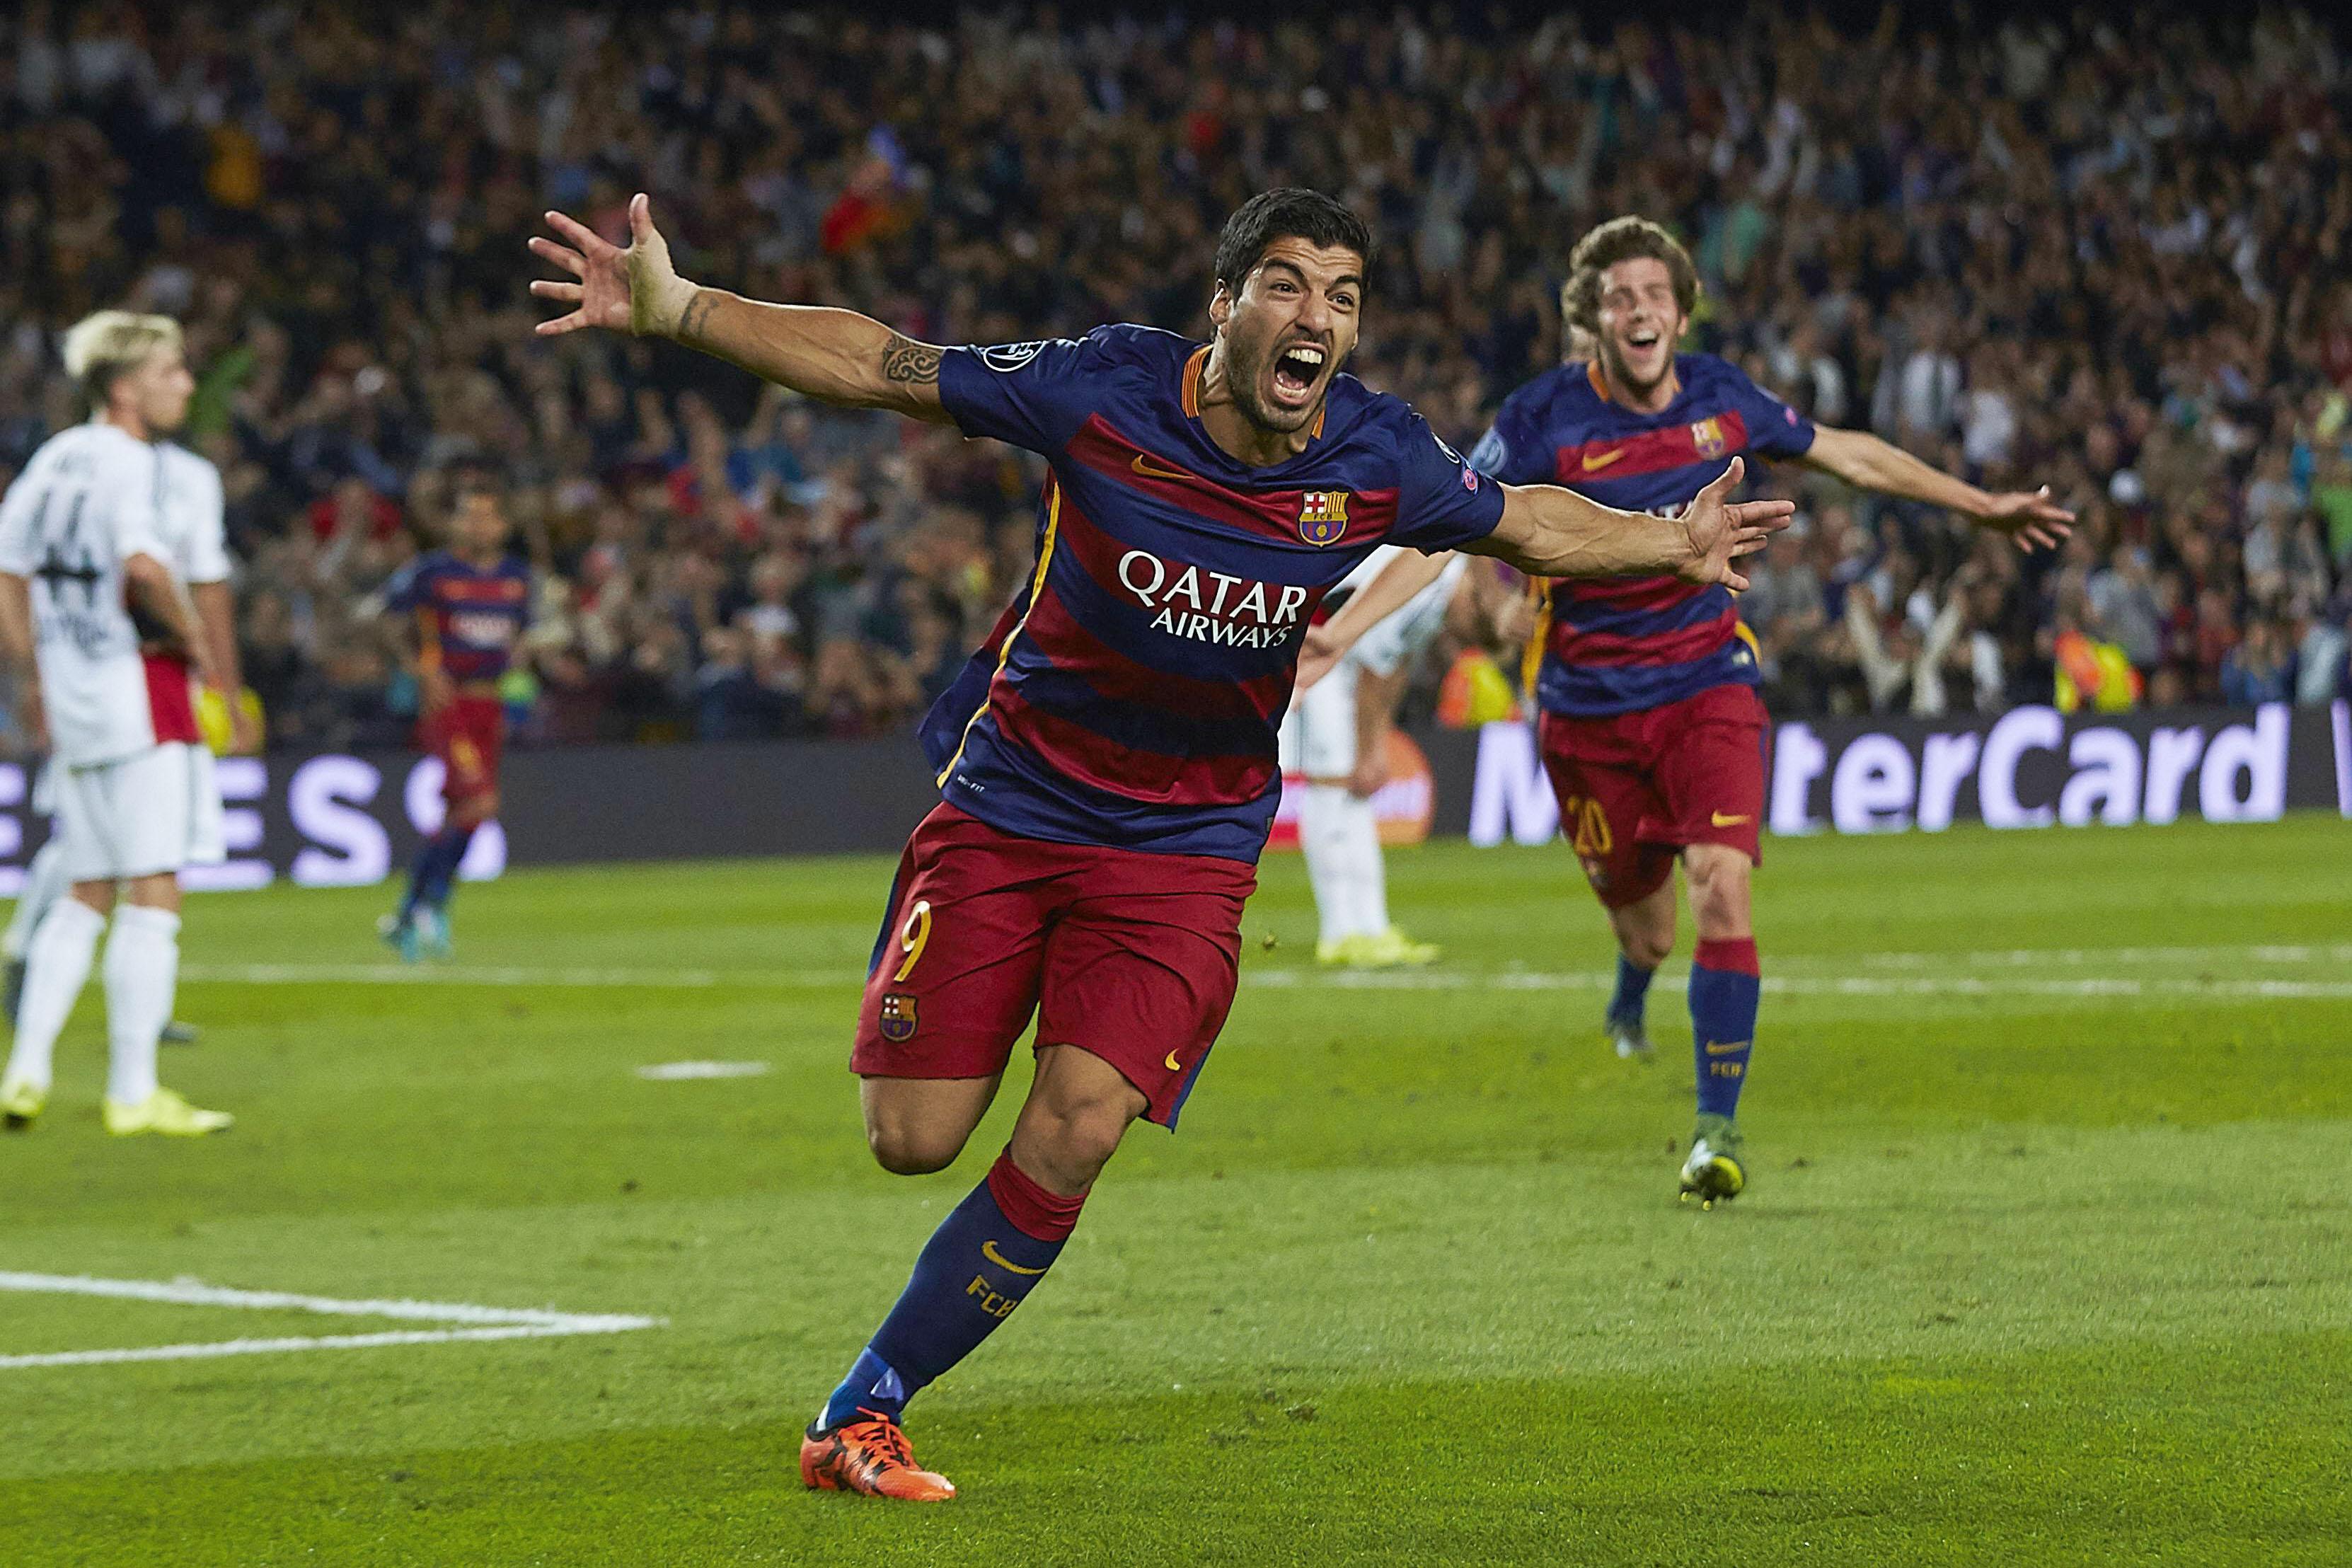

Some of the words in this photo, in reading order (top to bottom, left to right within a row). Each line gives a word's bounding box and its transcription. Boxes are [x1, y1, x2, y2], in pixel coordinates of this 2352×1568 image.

[1118, 550, 1307, 624] QATAR
[1149, 606, 1292, 649] AIRWAYS
[1468, 699, 2291, 847] MterCard
[1565, 795, 1613, 855] 20
[894, 900, 932, 982] 9
[965, 1274, 1018, 1317] FCB
